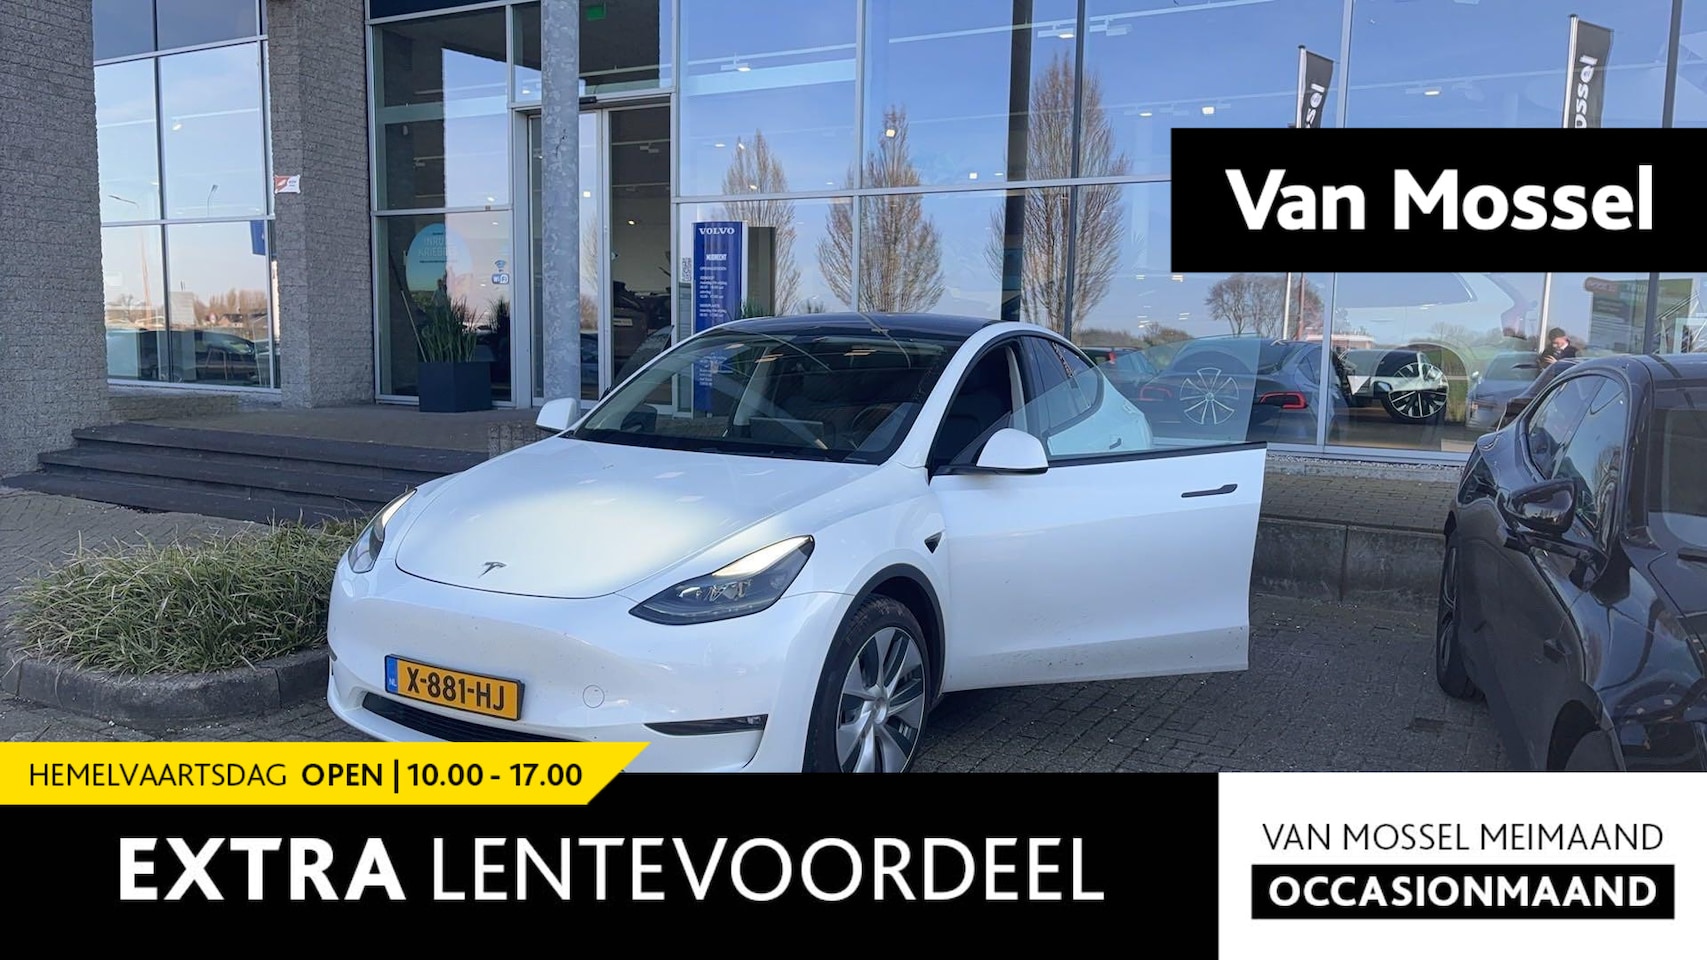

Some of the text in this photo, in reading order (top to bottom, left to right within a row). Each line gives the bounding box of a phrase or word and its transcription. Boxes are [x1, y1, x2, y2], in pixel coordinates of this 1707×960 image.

[1305, 83, 1325, 128] sel
[1574, 54, 1599, 128] ossel
[699, 227, 735, 235] VOLVO
[407, 666, 505, 711] X-881-HJ
